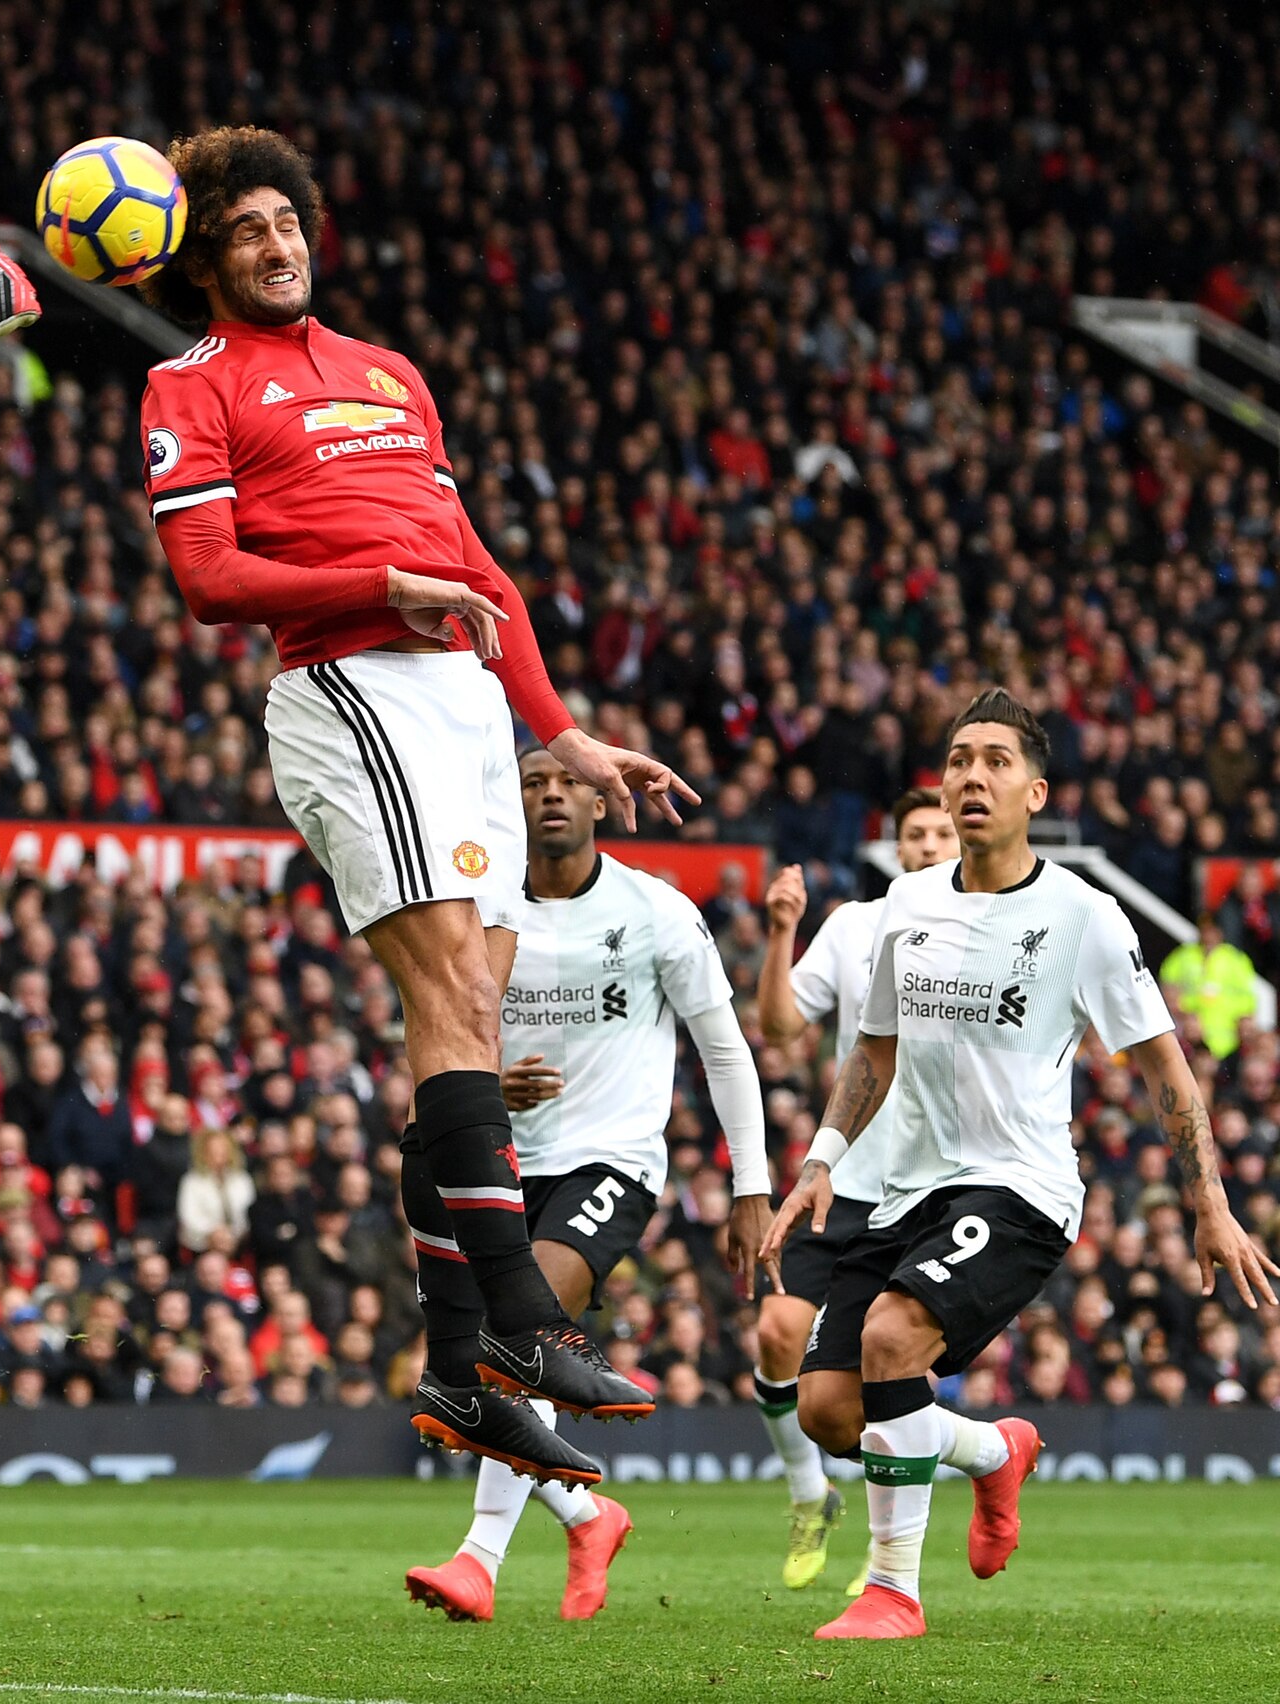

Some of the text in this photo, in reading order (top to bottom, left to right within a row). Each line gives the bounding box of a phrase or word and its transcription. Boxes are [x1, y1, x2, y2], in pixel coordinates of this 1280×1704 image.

[315, 433, 427, 462] CHEVROLET
[505, 984, 595, 1004] Standard
[903, 971, 994, 999] Standard
[501, 1007, 596, 1026] Chartered
[900, 997, 990, 1023] Chartered
[580, 1174, 626, 1223] 5
[942, 1214, 991, 1265] 9
